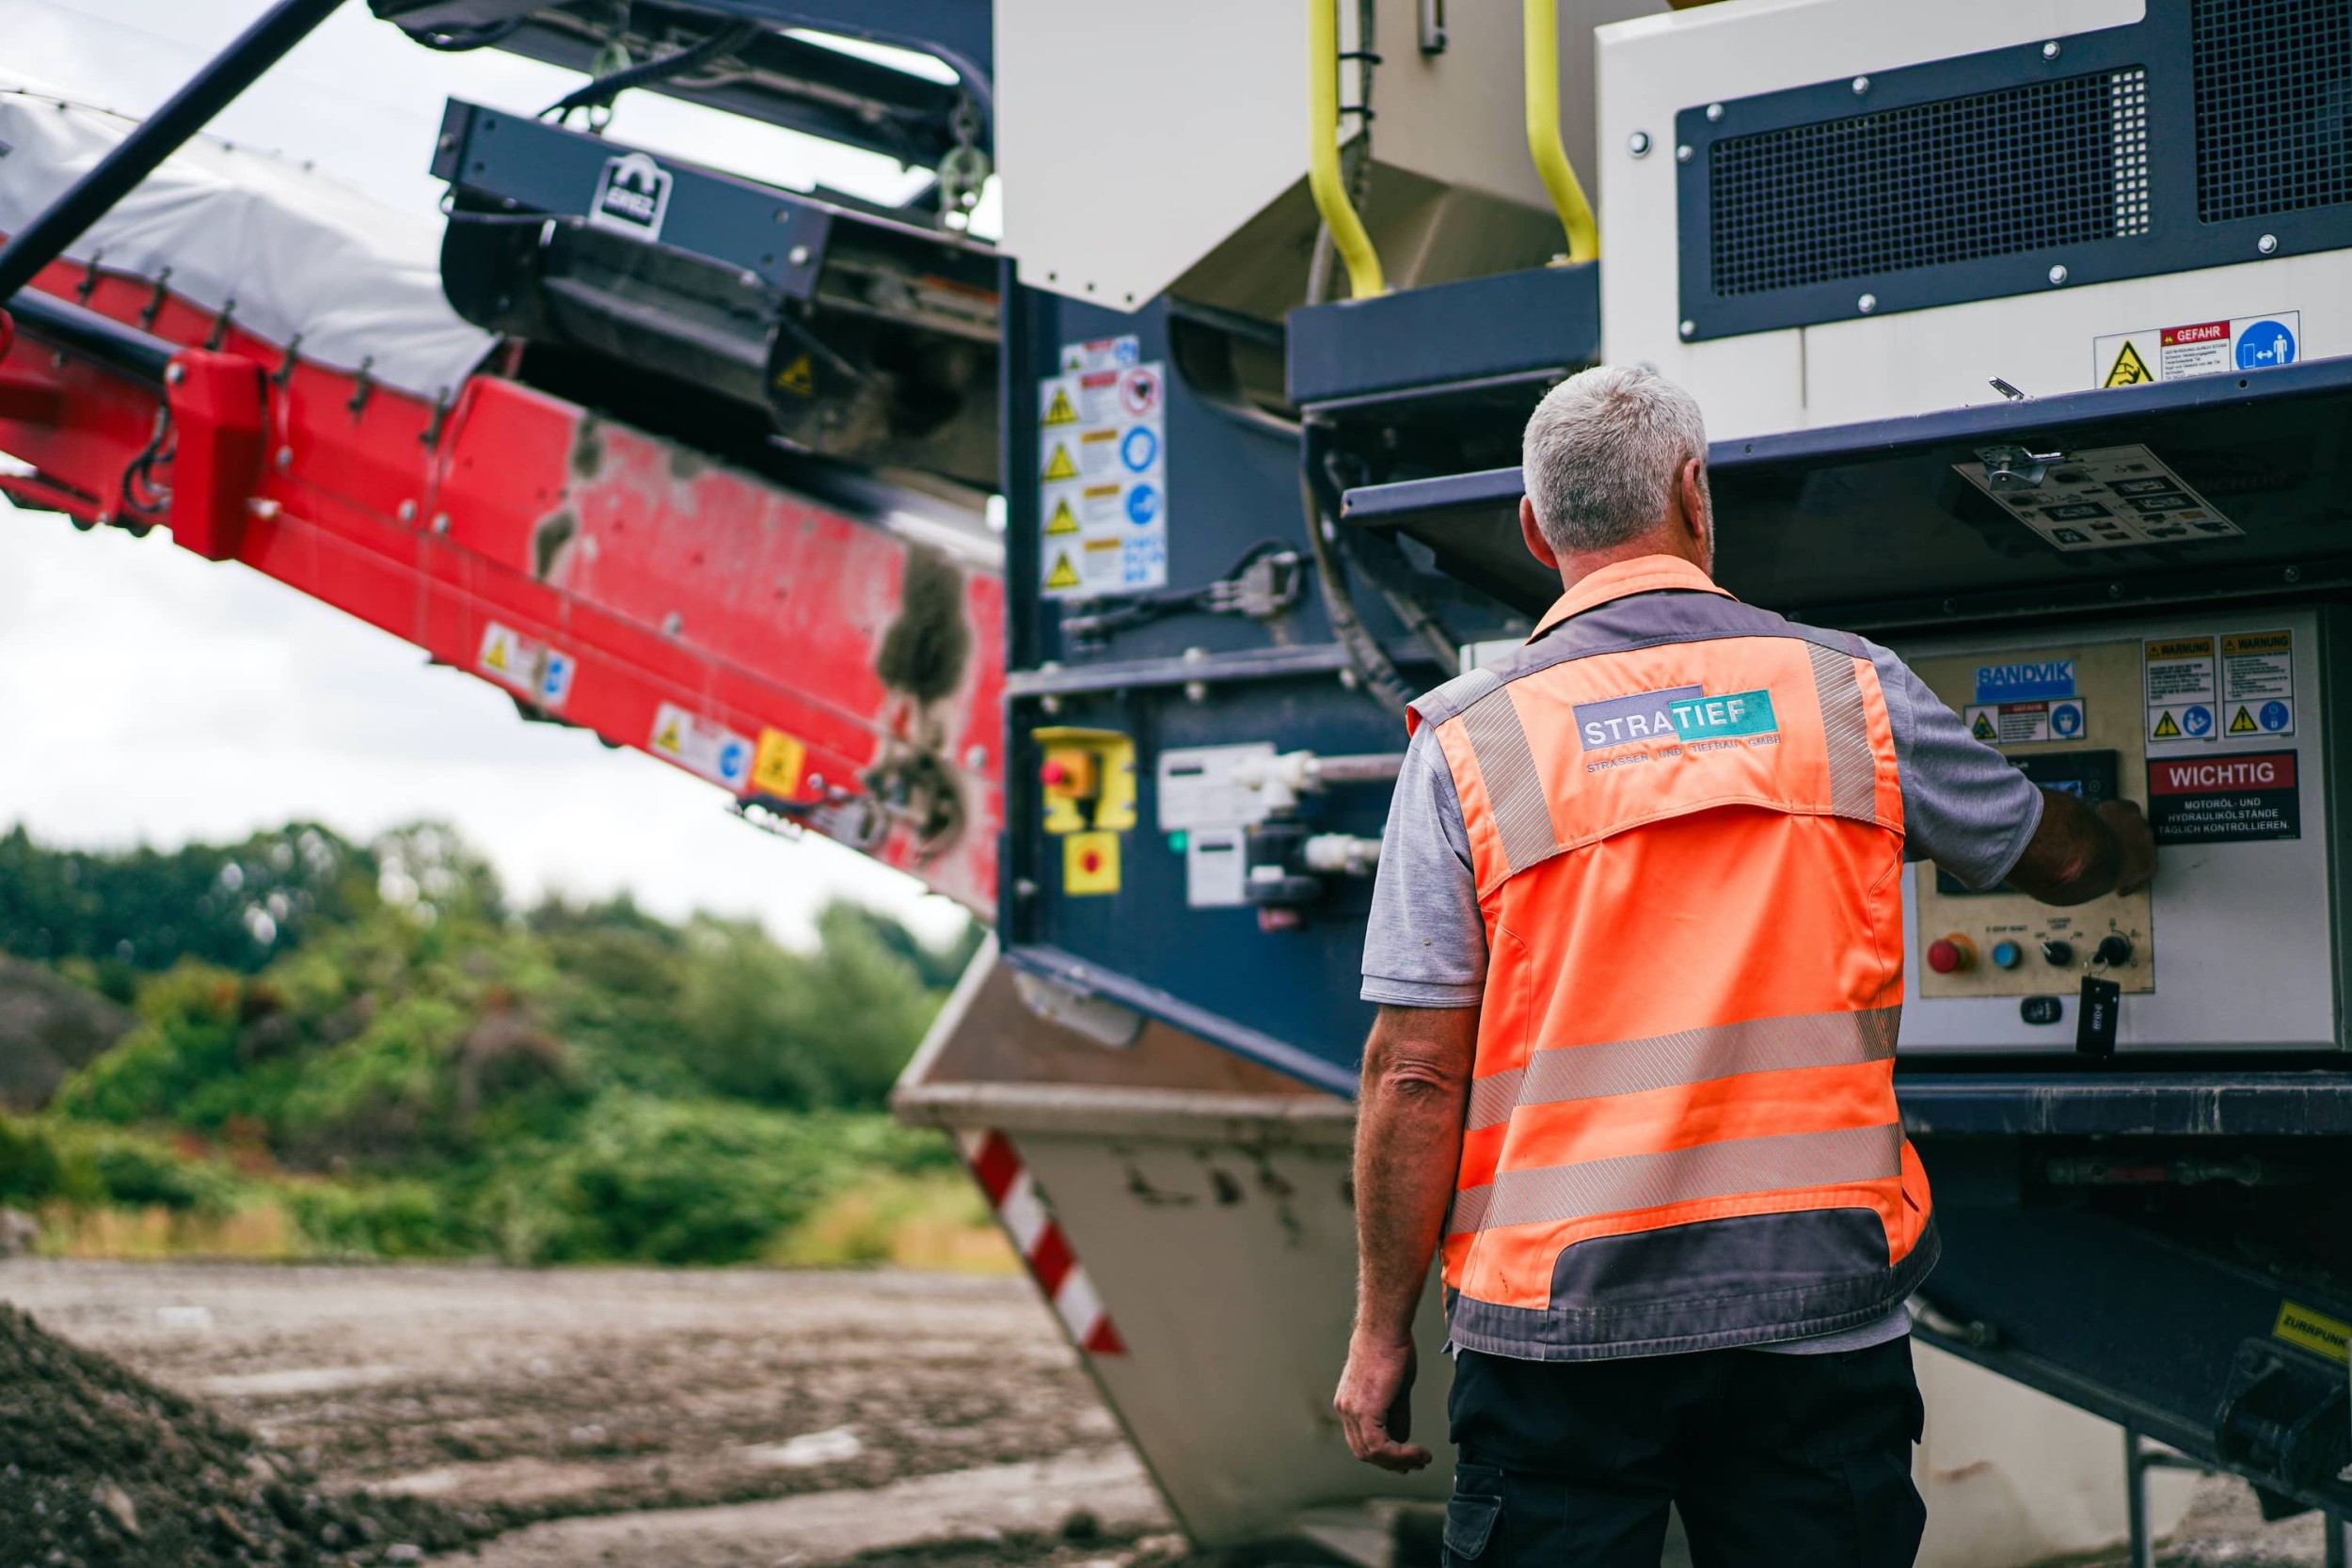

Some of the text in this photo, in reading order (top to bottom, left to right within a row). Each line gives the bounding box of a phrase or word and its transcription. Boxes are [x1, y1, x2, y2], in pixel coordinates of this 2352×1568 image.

[2177, 325, 2221, 341] GEFAHR
[2160, 641, 2210, 656] WARNUNG
[2238, 636, 2288, 649] WARNUNG
[1978, 661, 2071, 686] SANDVIK
[1584, 699, 1745, 745] STRATIEF
[1586, 735, 1782, 773] STRASSEN UND TIEFBAU GMBH
[2169, 762, 2276, 788] WICHTIG
[2185, 797, 2261, 810] MOTORÖL- UND
[2168, 808, 2280, 822] HYDRAULIKÖLSTÄNDE
[2202, 820, 2290, 833] KONTROLLIEREN.
[2283, 1314, 2347, 1348] ZURRPUNK
